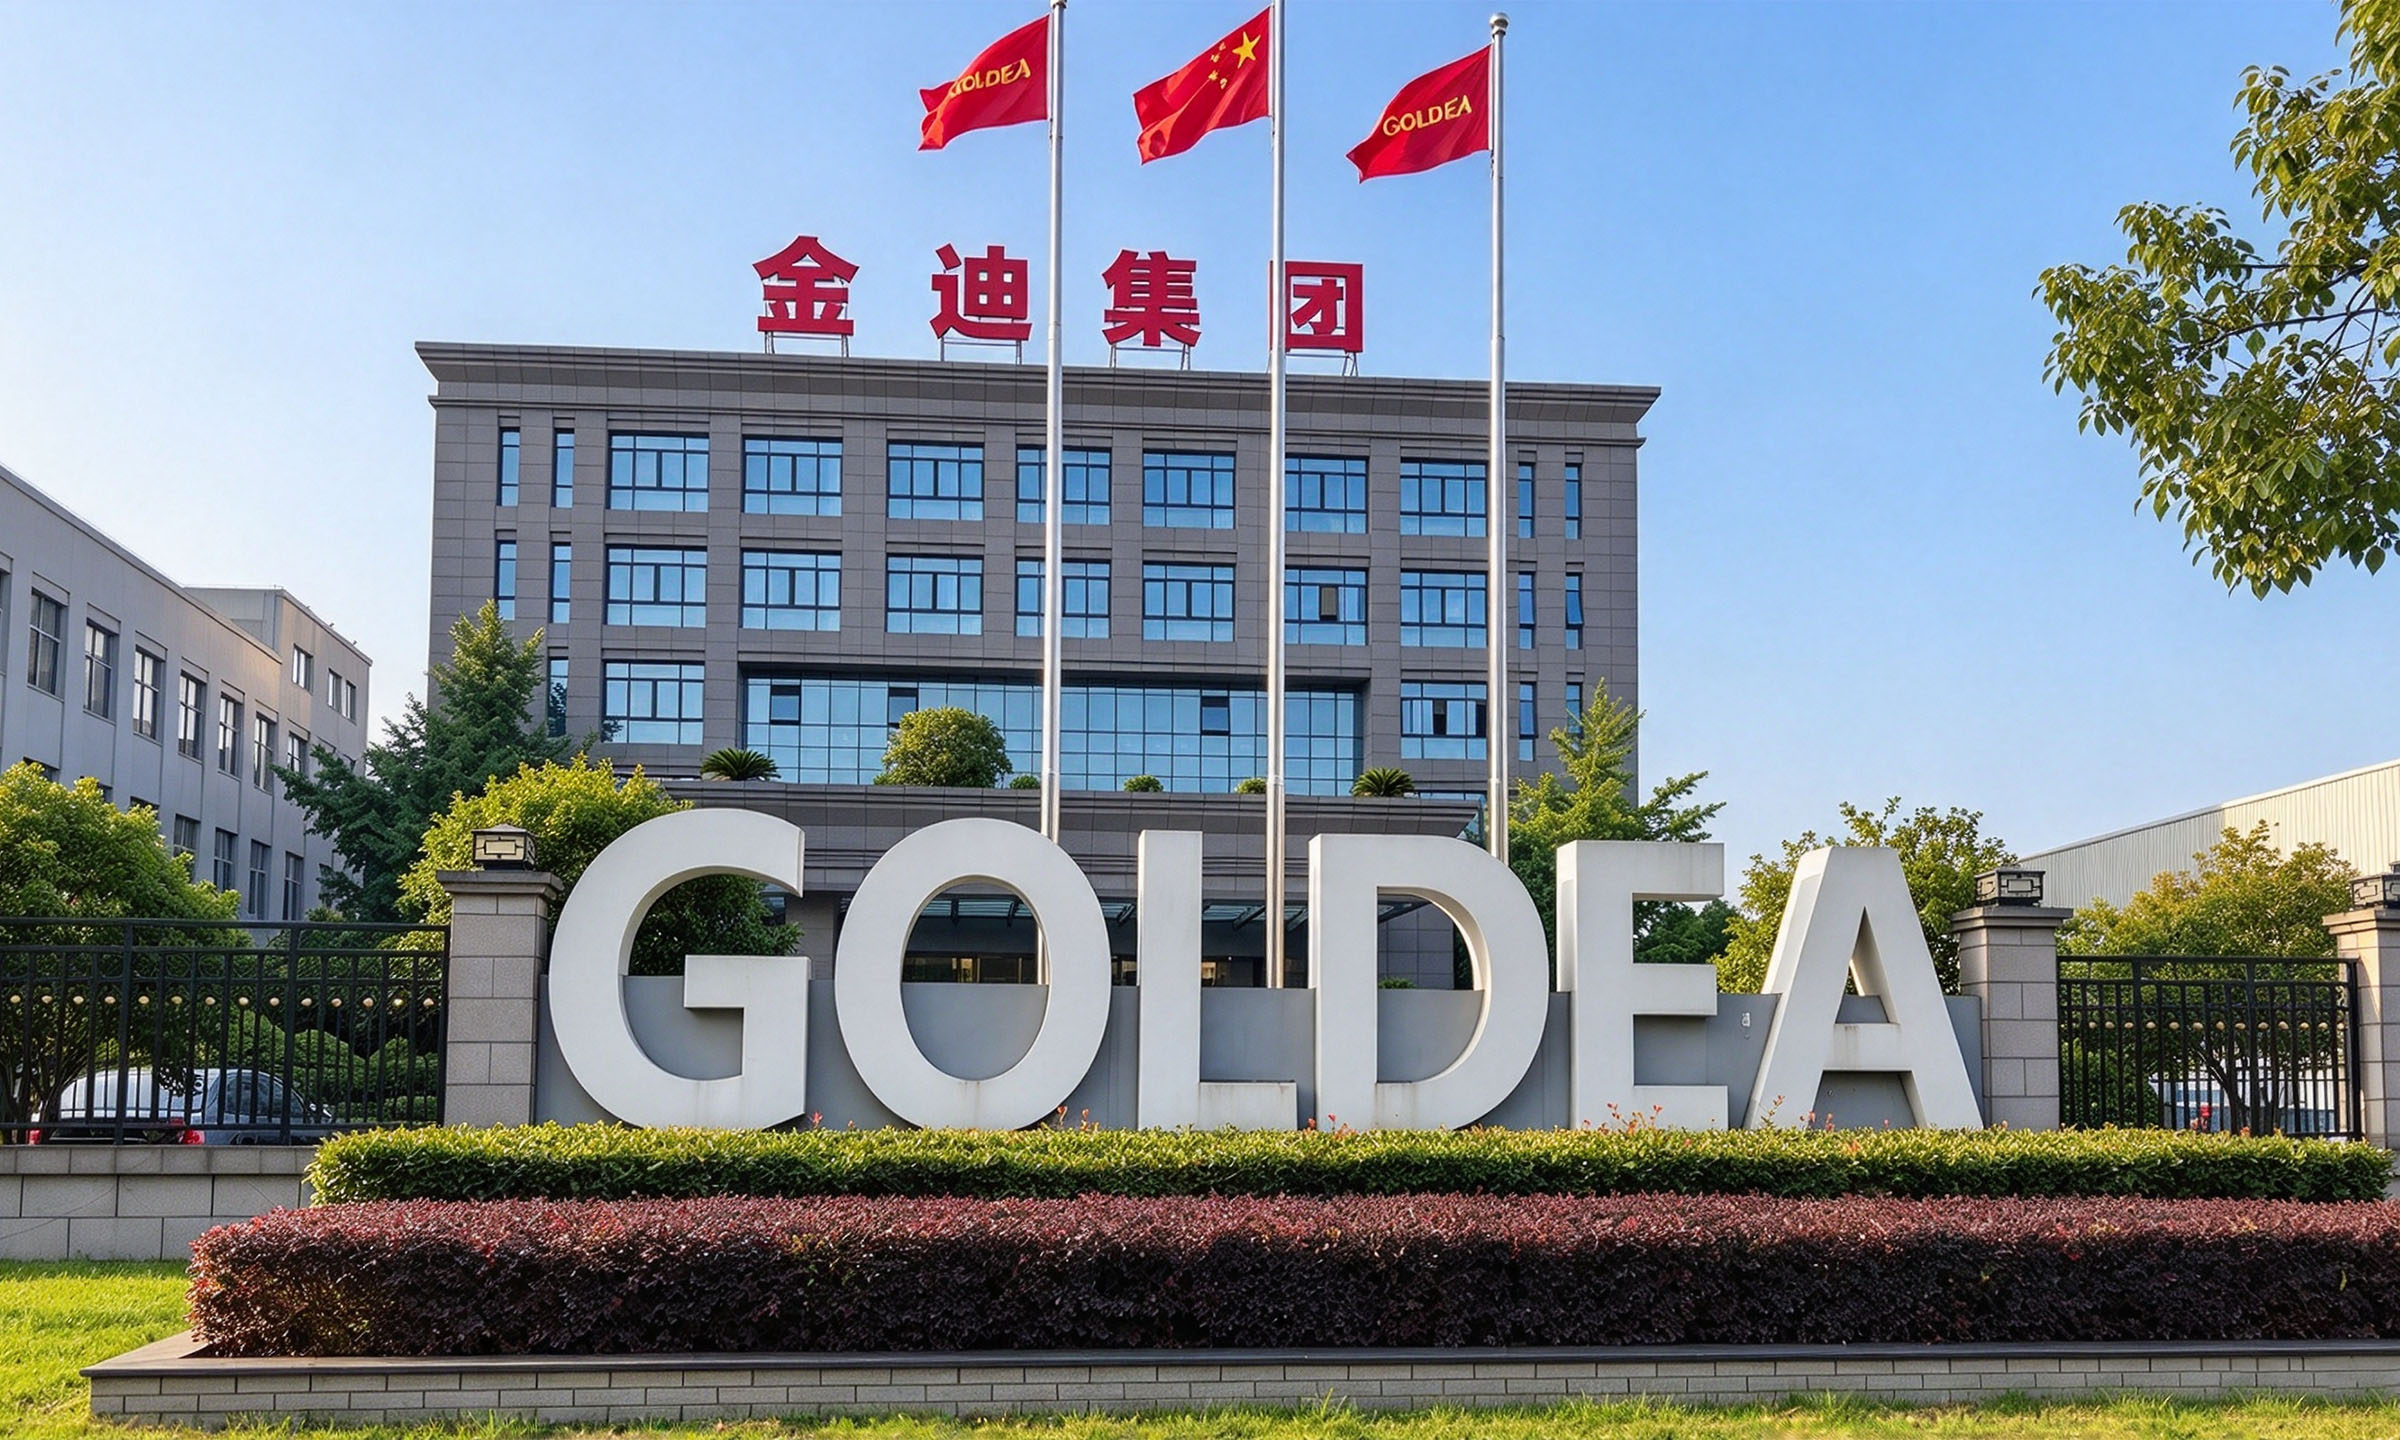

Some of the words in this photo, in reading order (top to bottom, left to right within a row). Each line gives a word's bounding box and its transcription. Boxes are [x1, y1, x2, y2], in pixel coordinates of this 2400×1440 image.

[1383, 95, 1473, 136] GOLDEA
[752, 235, 1363, 354] 金迪集团
[548, 808, 1984, 1131] GOLDEA
